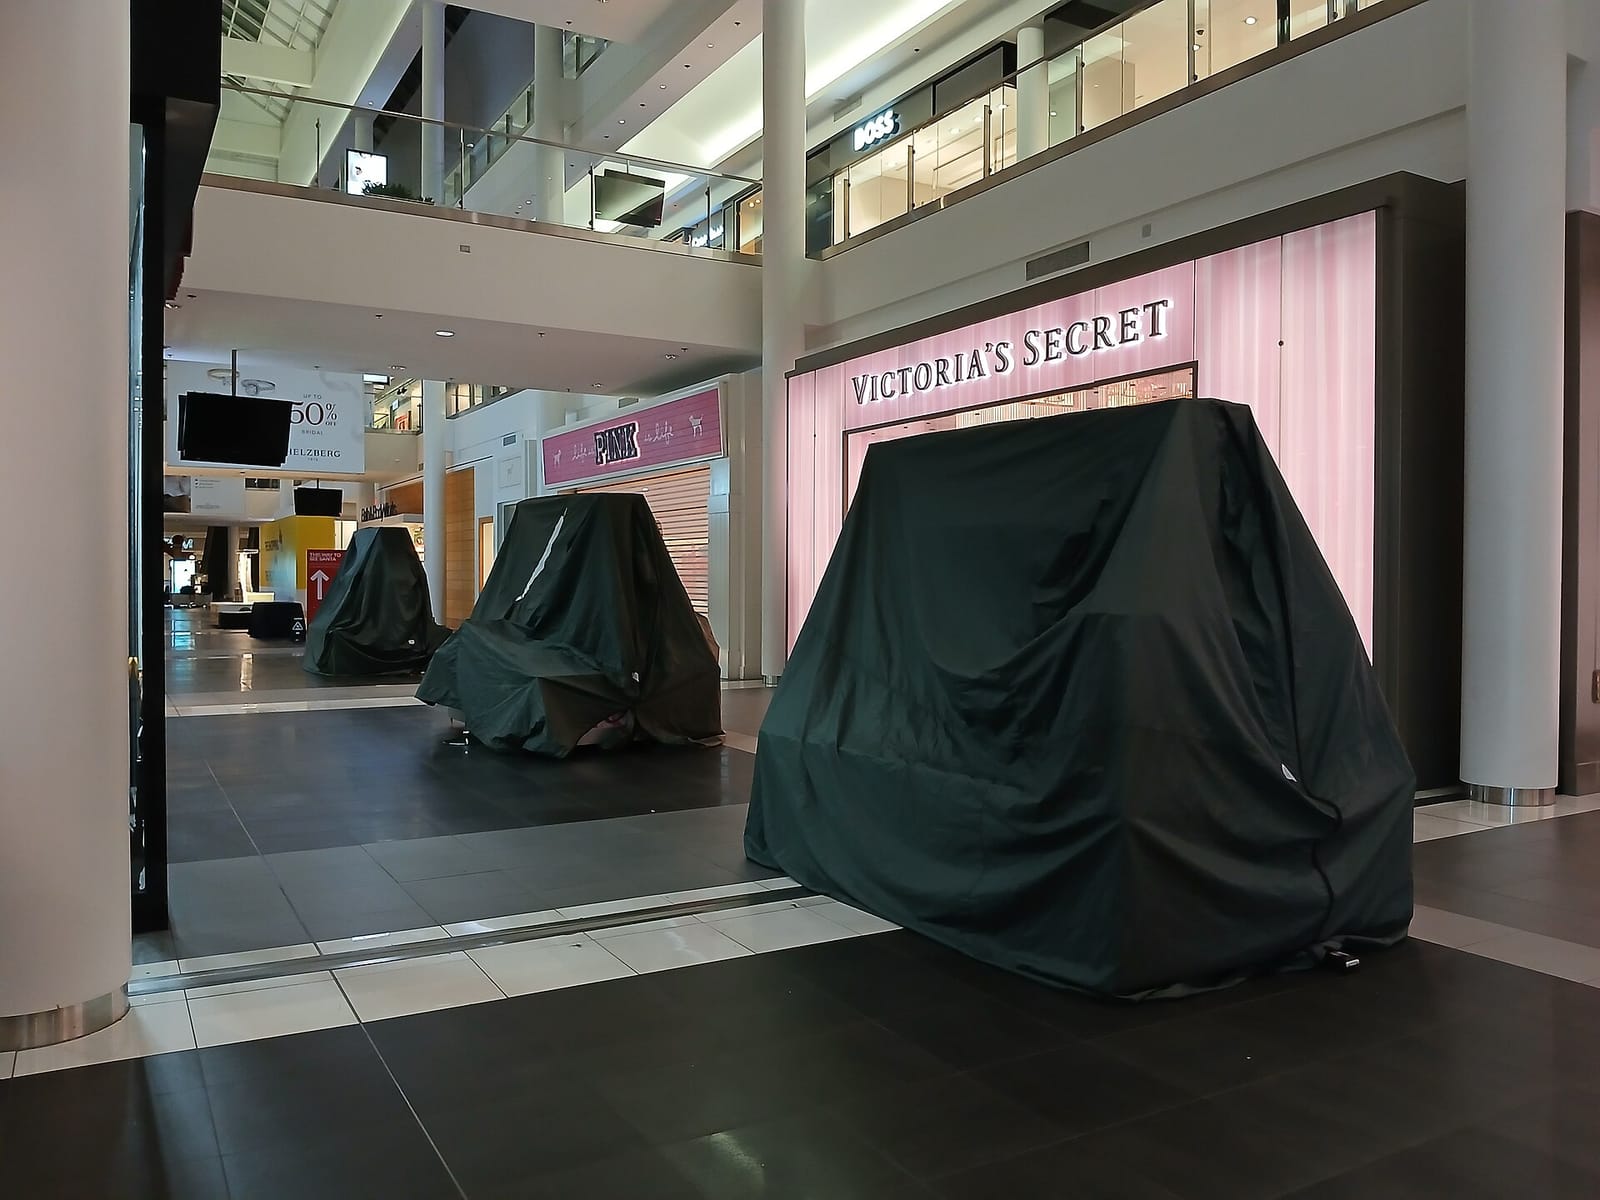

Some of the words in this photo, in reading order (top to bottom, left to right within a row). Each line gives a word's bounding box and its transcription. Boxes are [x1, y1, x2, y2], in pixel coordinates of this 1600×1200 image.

[854, 110, 898, 151] BOSS
[852, 342, 1009, 405] VICTORIA'S
[1023, 300, 1169, 367] SECRET
[290, 401, 337, 426] 50%
[595, 422, 640, 465] PINK
